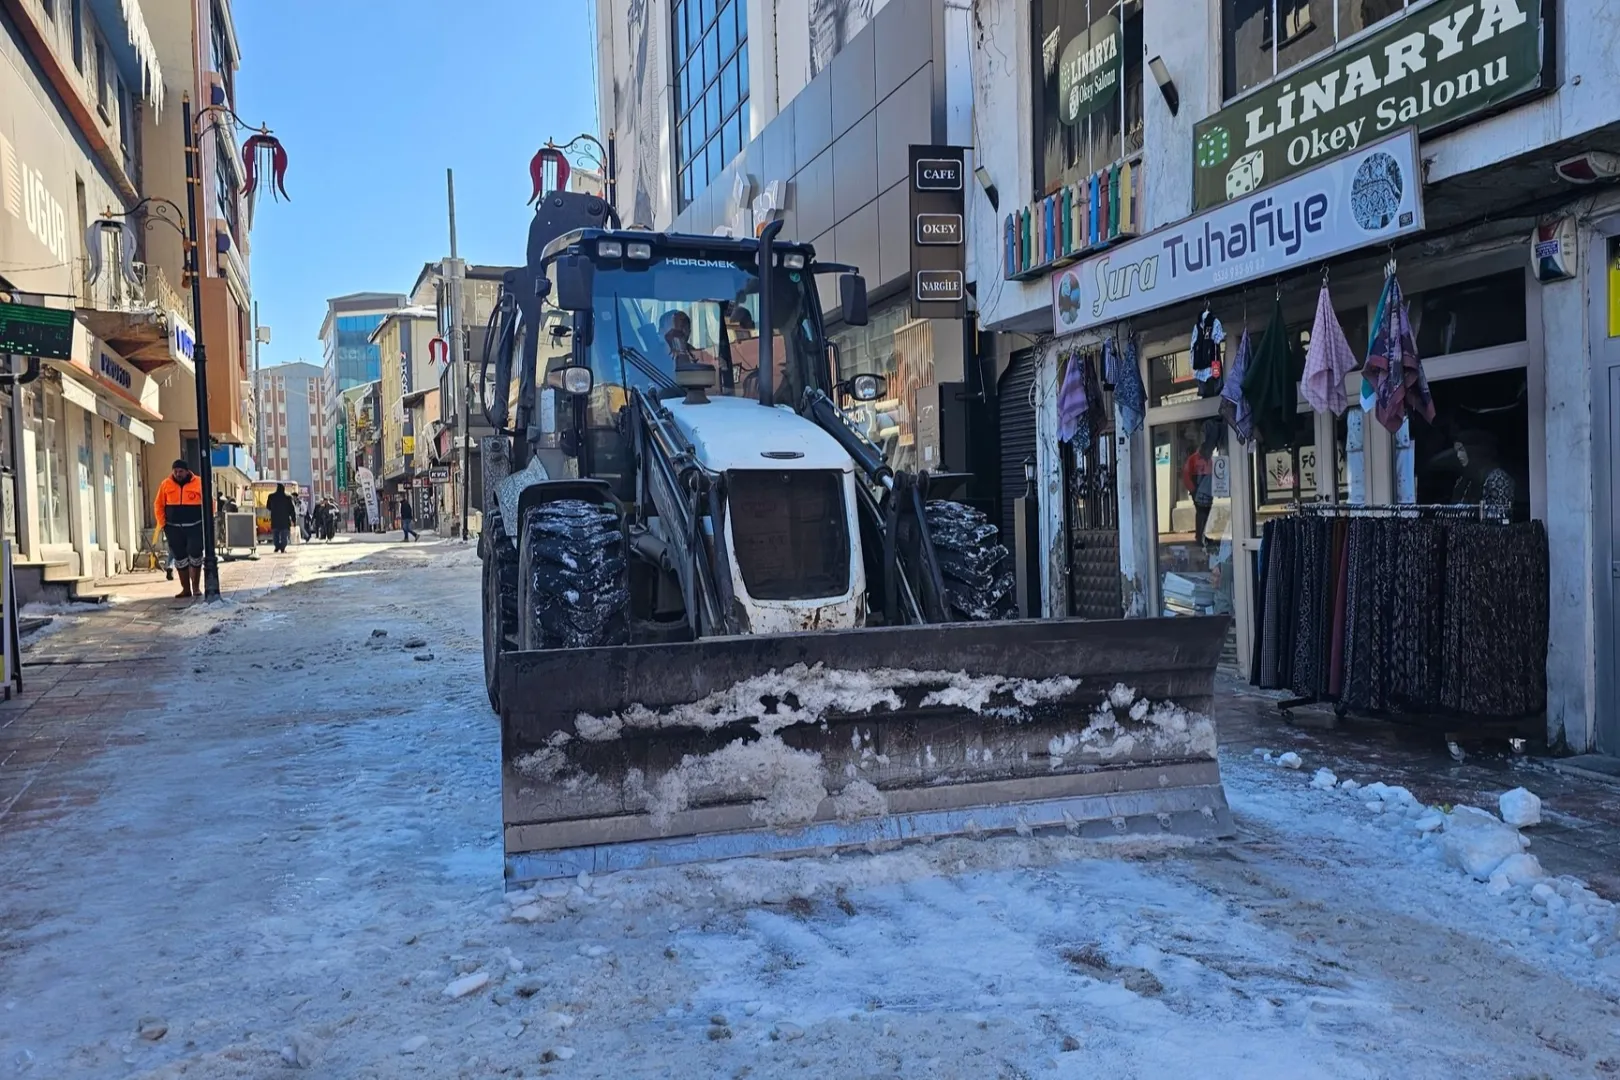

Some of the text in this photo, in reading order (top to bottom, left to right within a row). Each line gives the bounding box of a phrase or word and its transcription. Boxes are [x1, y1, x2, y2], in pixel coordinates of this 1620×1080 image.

[1071, 33, 1117, 84] LİNARYA
[1245, 0, 1526, 148] LİNARYA
[1079, 69, 1116, 103] Okey Salonu
[1286, 55, 1509, 167] Okey Salonu
[923, 169, 955, 179] CAFE
[22, 161, 68, 266] UĞUR
[922, 224, 957, 234] OKEY
[1163, 193, 1328, 278] Tuhafiye
[921, 279, 959, 291] NARGİLE
